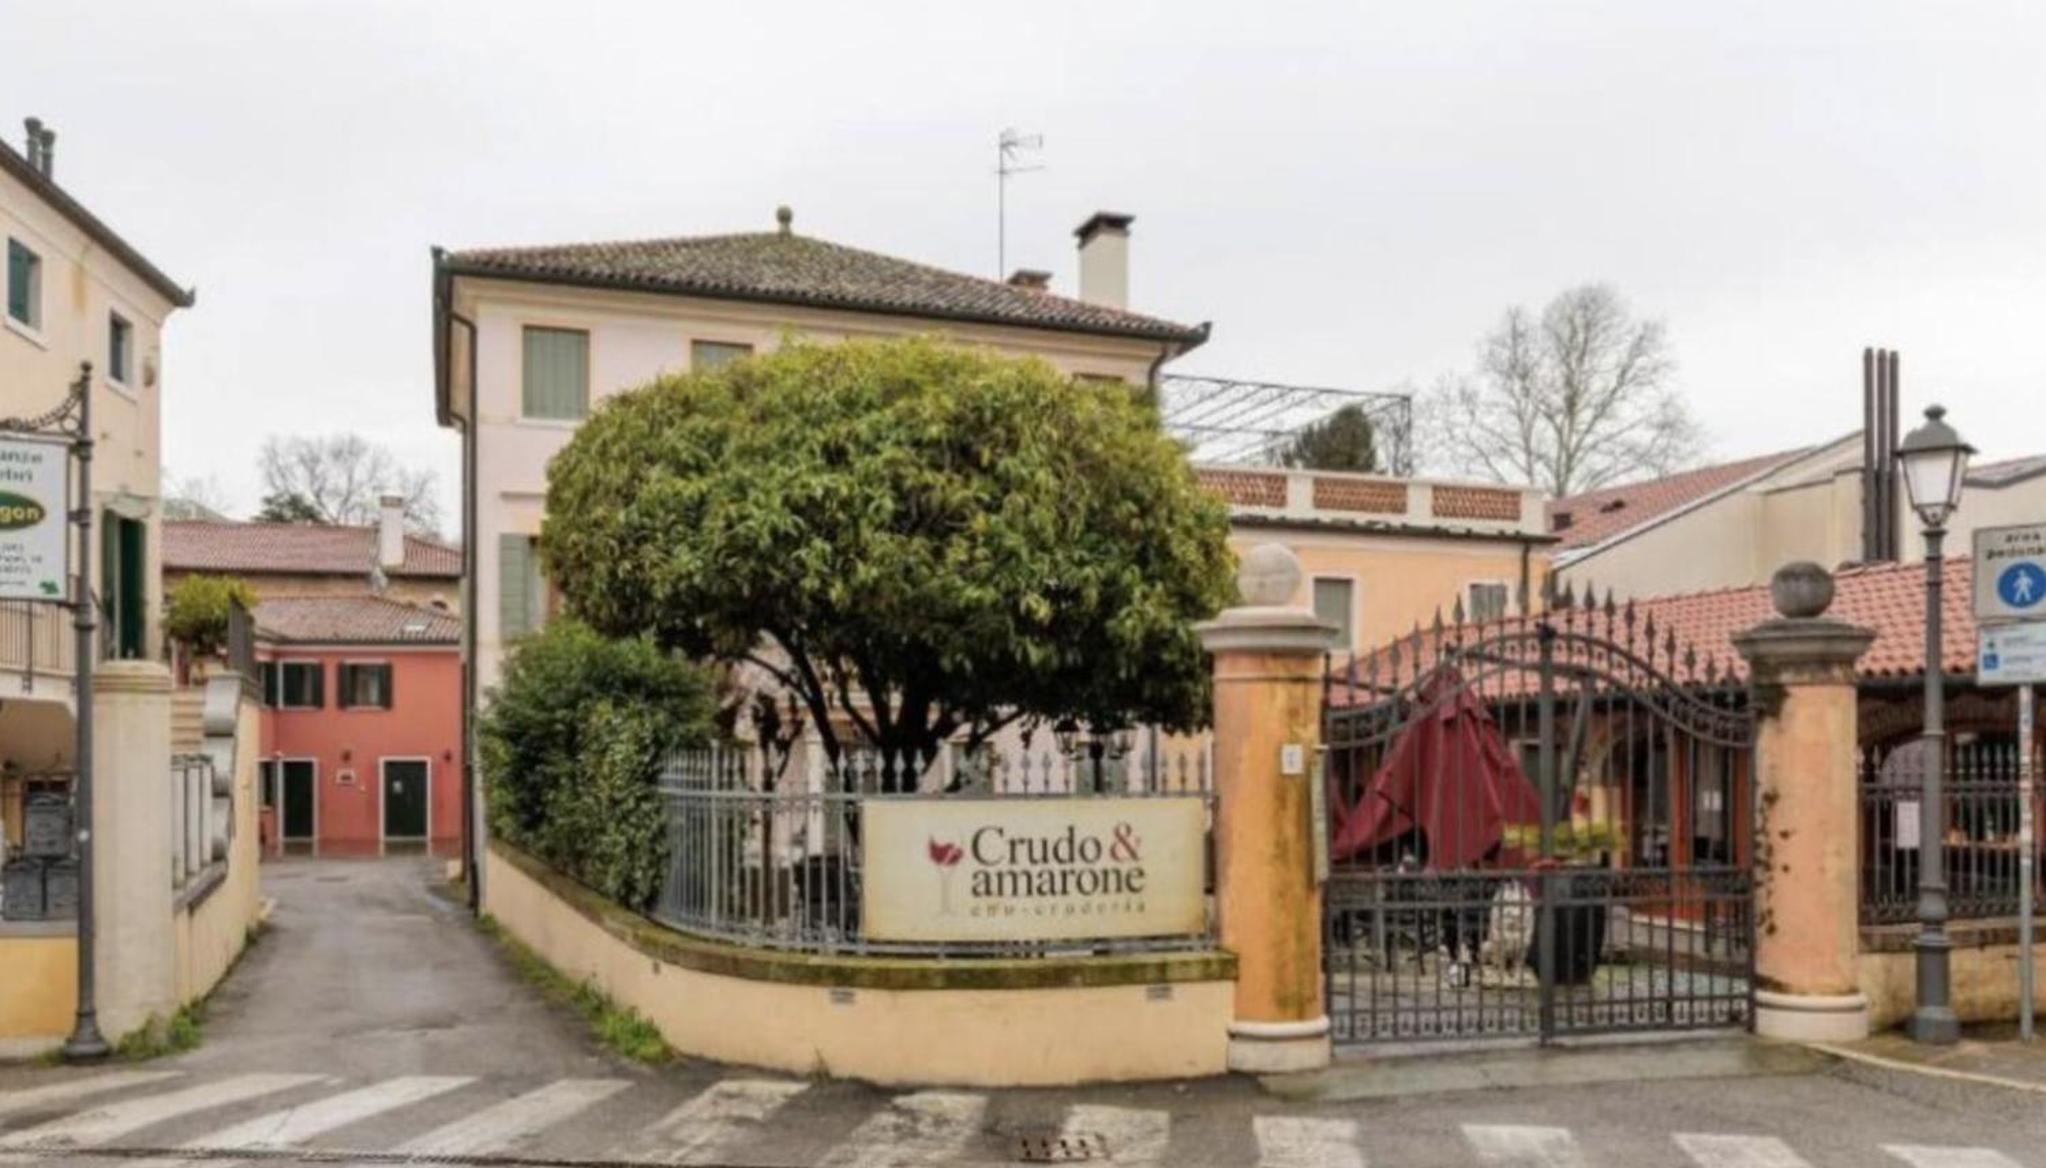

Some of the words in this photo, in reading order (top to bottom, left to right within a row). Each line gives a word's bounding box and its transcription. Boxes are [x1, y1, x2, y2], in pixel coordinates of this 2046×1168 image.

[971, 825, 1102, 866] Crudo
[1109, 821, 1142, 862] &
[971, 866, 1146, 897] amarone
